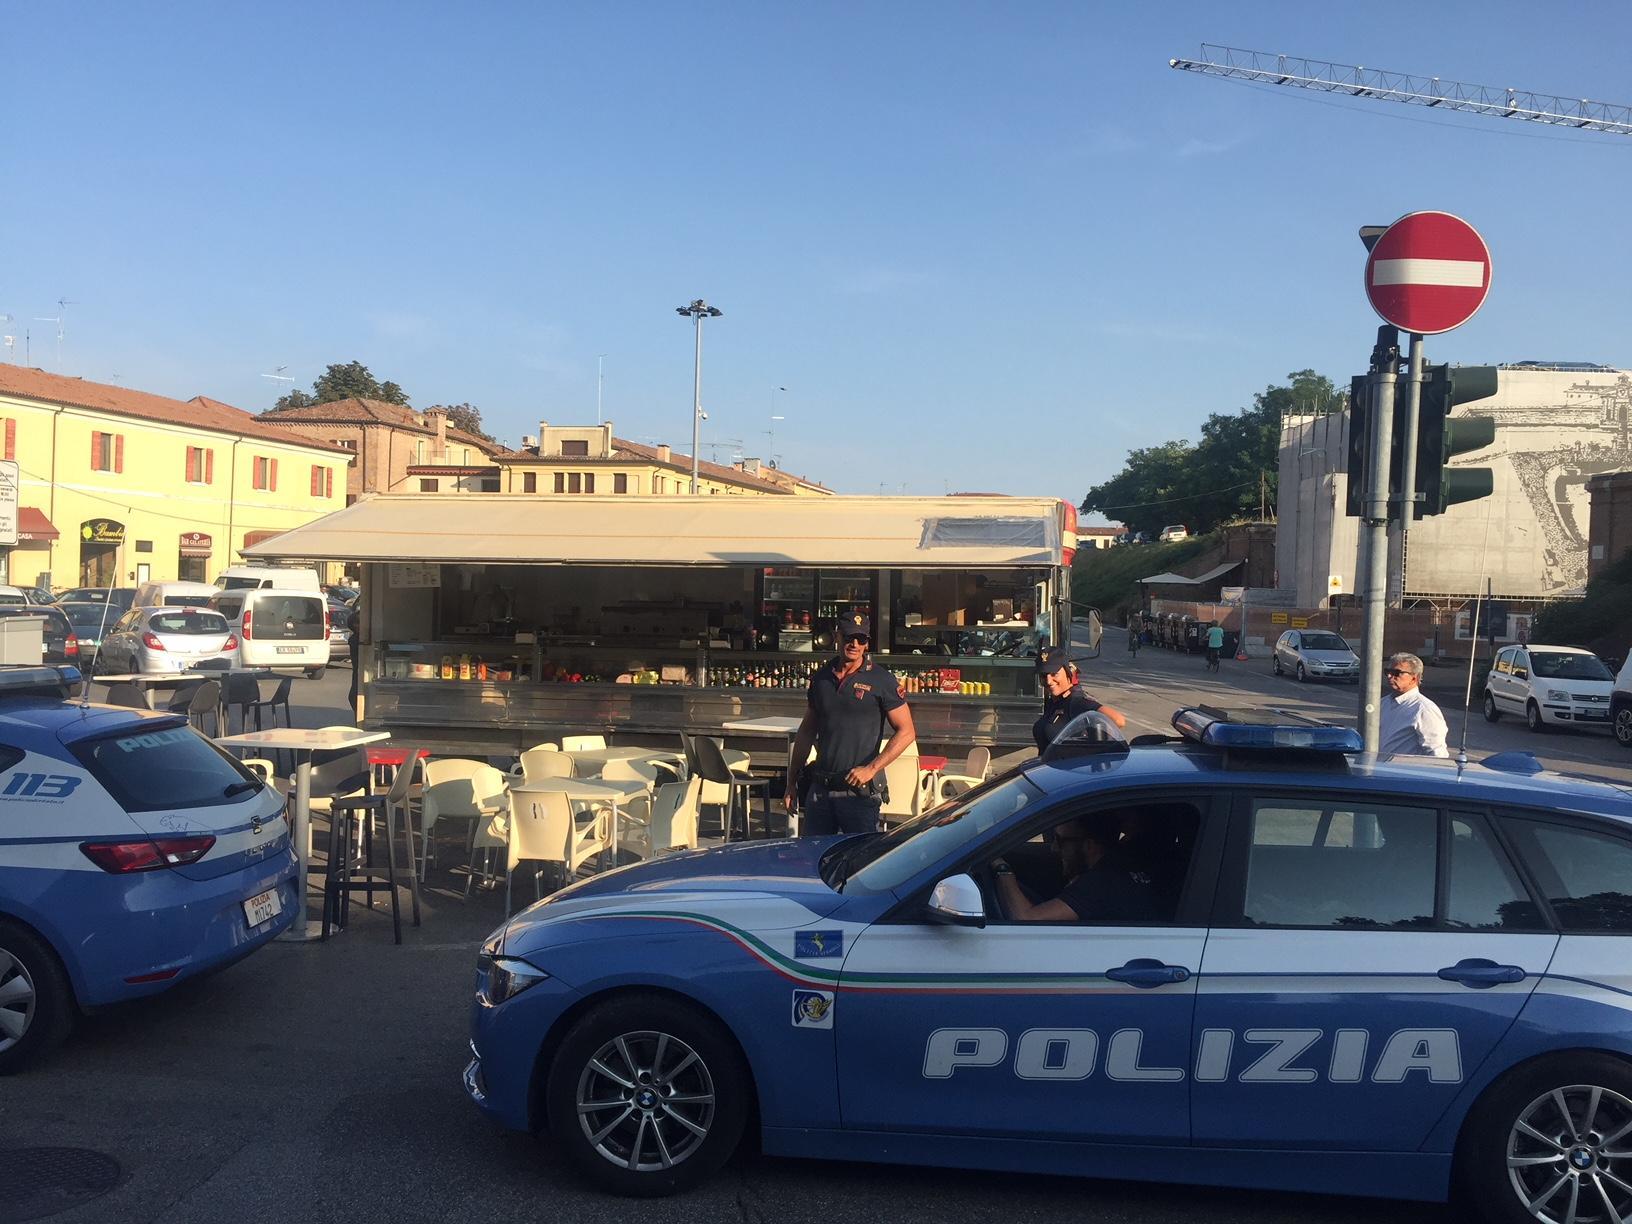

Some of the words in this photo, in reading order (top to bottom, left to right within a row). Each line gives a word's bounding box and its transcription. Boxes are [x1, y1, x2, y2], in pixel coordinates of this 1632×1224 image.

[2, 772, 82, 798] 113
[251, 893, 271, 908] POLIZIA
[922, 1028, 1464, 1084] POLIZIA
